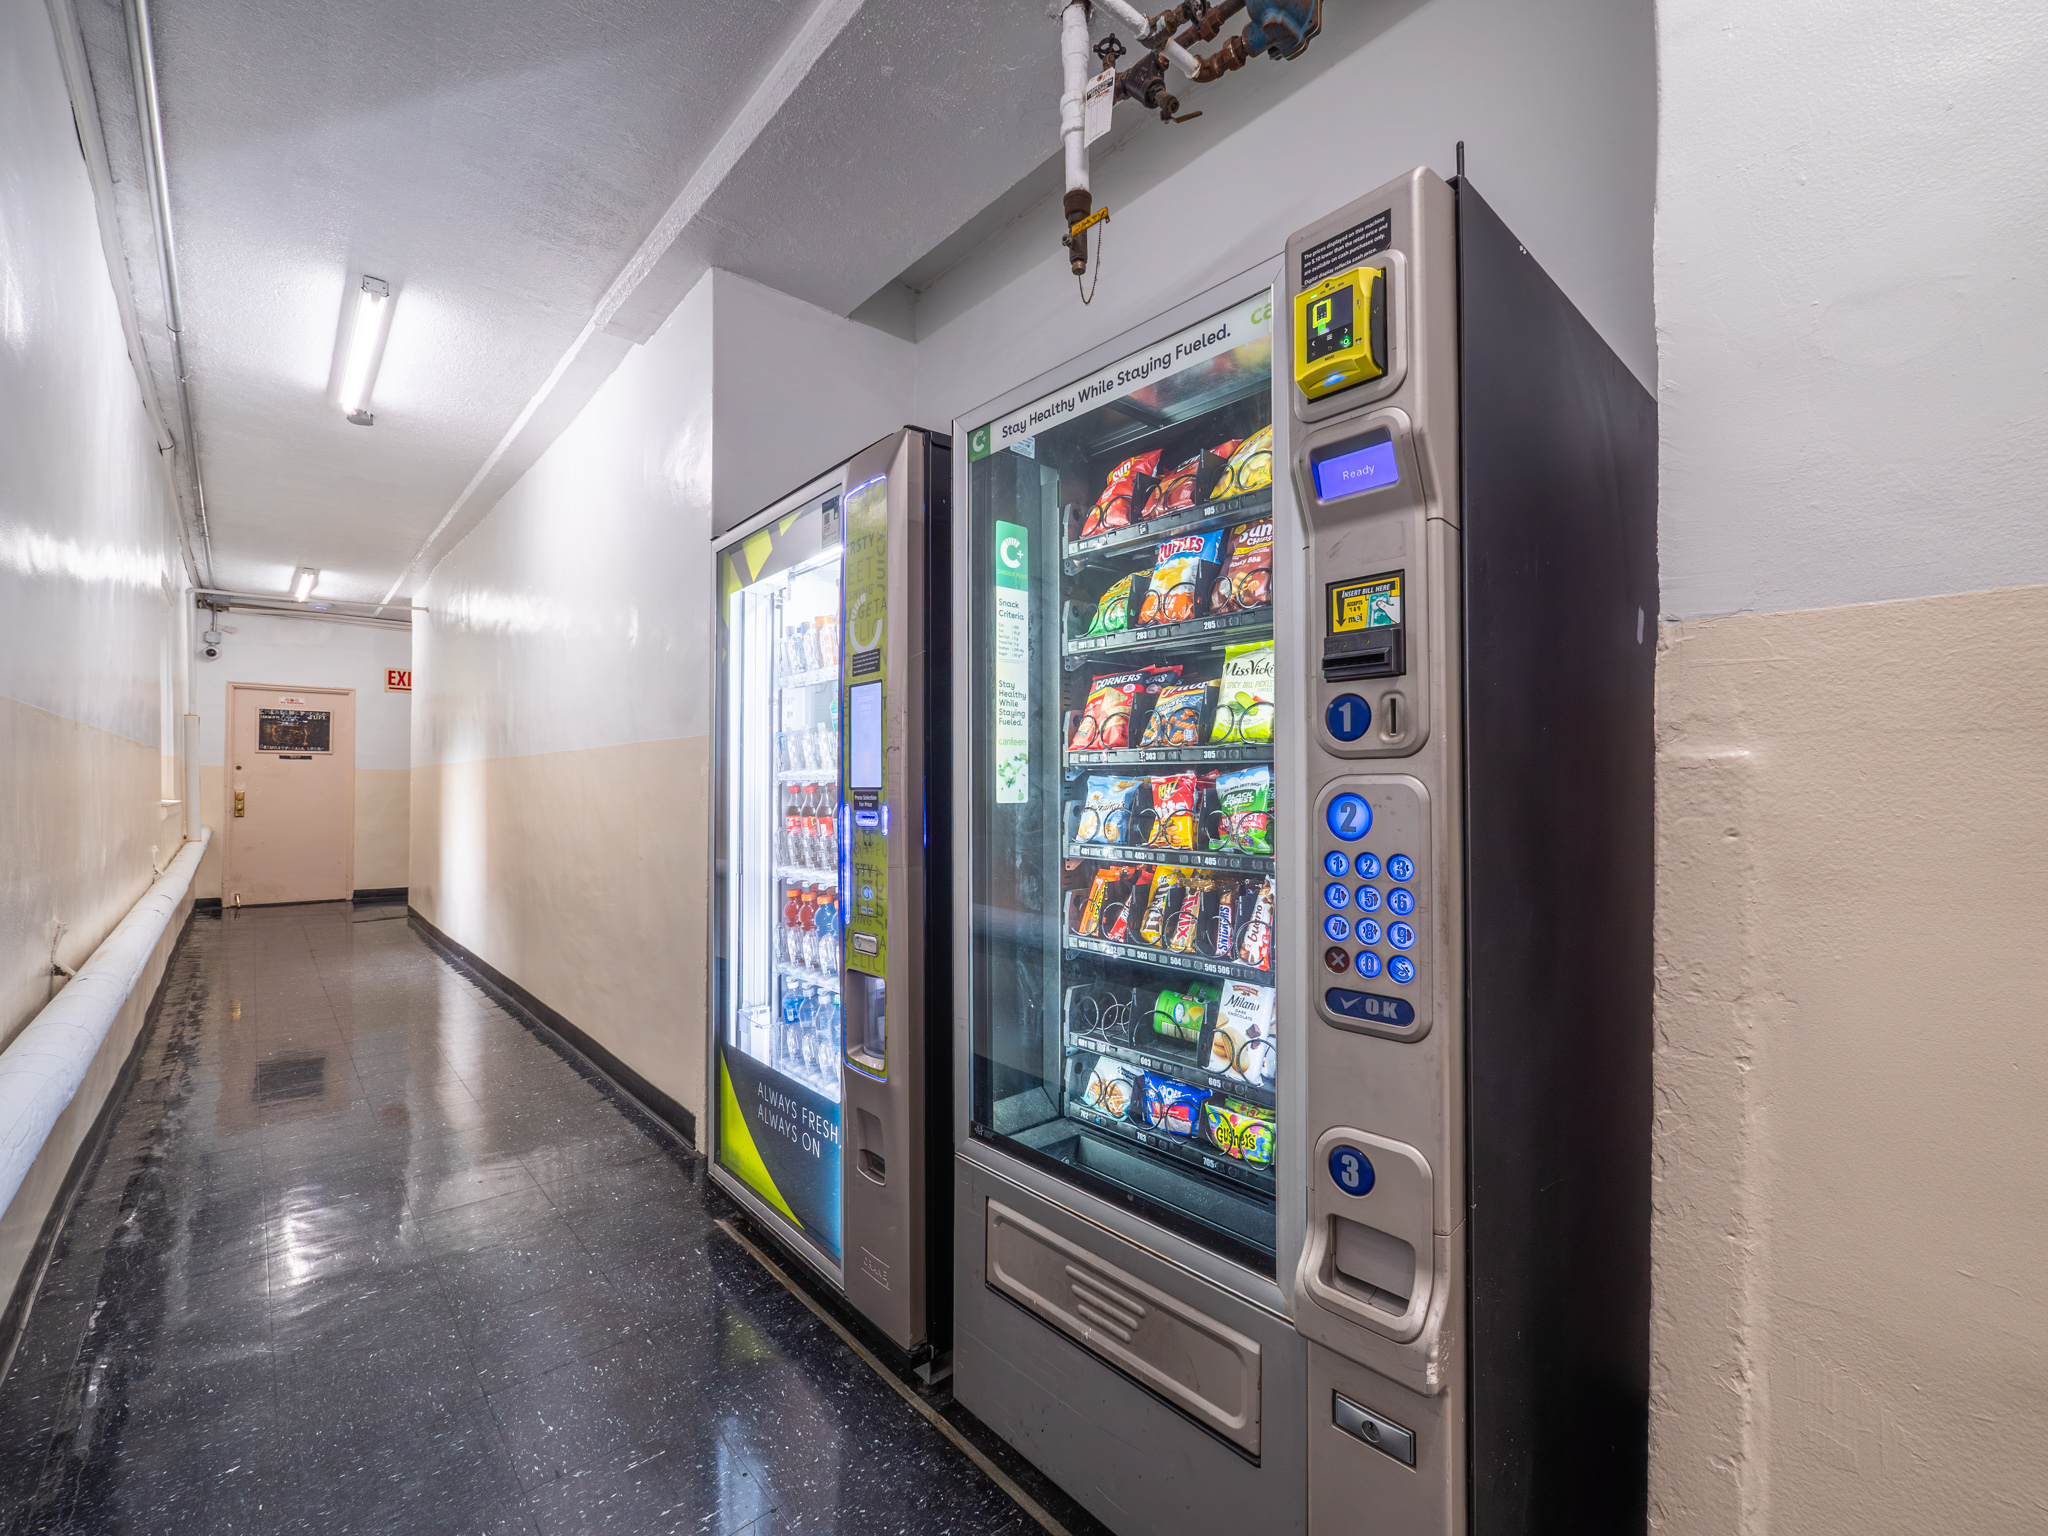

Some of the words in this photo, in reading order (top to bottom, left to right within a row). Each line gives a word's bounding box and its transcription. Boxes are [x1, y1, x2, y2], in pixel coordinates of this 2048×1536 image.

[1304, 252, 1312, 260] The
[1312, 246, 1326, 257] prices
[1326, 234, 1348, 250] displayed
[1355, 227, 1364, 236] this
[1364, 216, 1385, 230] machine
[1320, 250, 1334, 260] lower
[1334, 245, 1344, 254] than
[1345, 241, 1353, 249] the
[1353, 235, 1365, 245] retail
[1366, 229, 1377, 240] price
[1378, 223, 1388, 232] and
[1312, 260, 1330, 273] available
[1338, 250, 1349, 259] cash
[1350, 239, 1373, 254] purchases
[1374, 233, 1386, 242] only.
[1304, 276, 1318, 286] Digital
[1318, 268, 1334, 279] display
[1334, 260, 1352, 271] reflects
[1352, 254, 1363, 262] cash
[1364, 248, 1377, 258] price.
[1002, 414, 1027, 438] Stay
[1030, 395, 1075, 425] Healthy
[1078, 380, 1114, 403] While
[1117, 350, 1172, 386] Staying
[1175, 323, 1231, 361] Fueled.
[1342, 464, 1375, 480] Ready
[1204, 506, 1215, 516] 105
[1342, 590, 1361, 598] INSERT
[1375, 584, 1390, 592] HERE
[998, 598, 1019, 609] Snack
[998, 610, 1024, 621] Criteria
[1348, 613, 1362, 623] mei
[1204, 621, 1216, 630] 205
[1137, 631, 1147, 640] 203
[388, 670, 411, 686] EXI
[1095, 673, 1142, 690] CORNERS
[999, 680, 1015, 690] Stay
[1227, 681, 1241, 689] SPICY
[999, 690, 1026, 700] Healthy
[999, 699, 1018, 707] While
[999, 708, 1025, 719] Staying
[1339, 702, 1352, 732] 1
[999, 718, 1023, 726] Fueled.
[999, 738, 1026, 746] canteen
[1204, 750, 1216, 758] 305
[1226, 791, 1253, 800] BLACK
[1223, 798, 1252, 807] FOREST
[1340, 802, 1357, 832] 2
[1204, 857, 1216, 865] 405
[1334, 856, 1341, 872] 1
[1363, 858, 1373, 874] 2
[1396, 860, 1406, 877] 3
[1333, 888, 1342, 904] 4
[1365, 891, 1374, 907] 5
[1397, 894, 1407, 911] 6
[1177, 892, 1200, 941] TWIX
[1218, 905, 1230, 951] SNICKERS
[1334, 920, 1342, 935] 7
[1365, 923, 1374, 940] 8
[1397, 927, 1406, 944] 9
[1136, 951, 1148, 960] 503
[1170, 957, 1182, 966] 504
[1204, 963, 1216, 972] 505
[1218, 965, 1230, 975] 506
[1365, 956, 1374, 972] 0
[1224, 995, 1260, 1012] Milano
[1365, 998, 1398, 1019] OK
[1228, 1011, 1253, 1021] CHOCOLATE
[1140, 1056, 1151, 1067] 603
[1209, 1078, 1221, 1088] 605
[757, 1081, 797, 1119] ALWAYS
[757, 1104, 798, 1143] ALWAYS
[802, 1132, 821, 1158] ON
[1216, 1126, 1256, 1150] Gushers
[1340, 1154, 1359, 1187] 3
